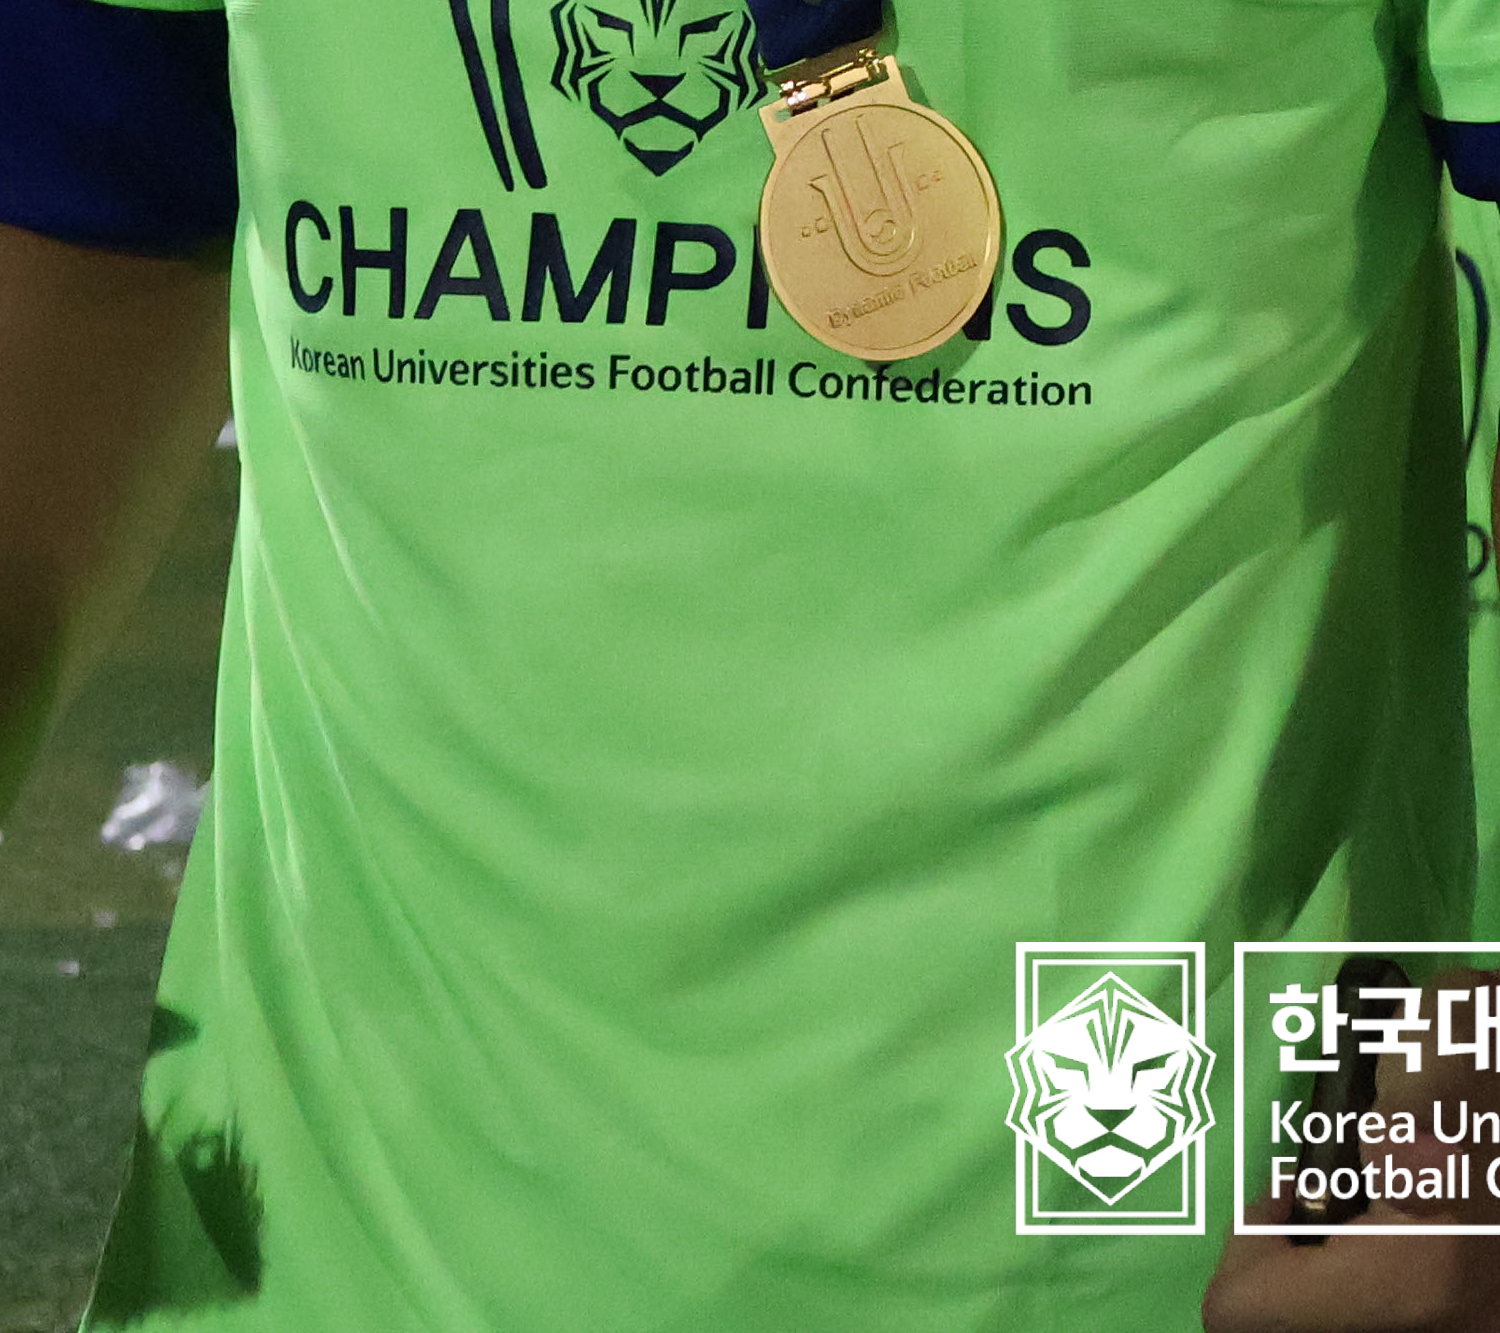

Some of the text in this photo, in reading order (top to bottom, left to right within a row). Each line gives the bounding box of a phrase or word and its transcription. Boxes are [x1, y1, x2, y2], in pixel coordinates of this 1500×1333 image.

[285, 199, 1092, 347] CHAMPIS
[291, 335, 1093, 407] Korean Universities Football Confederation
